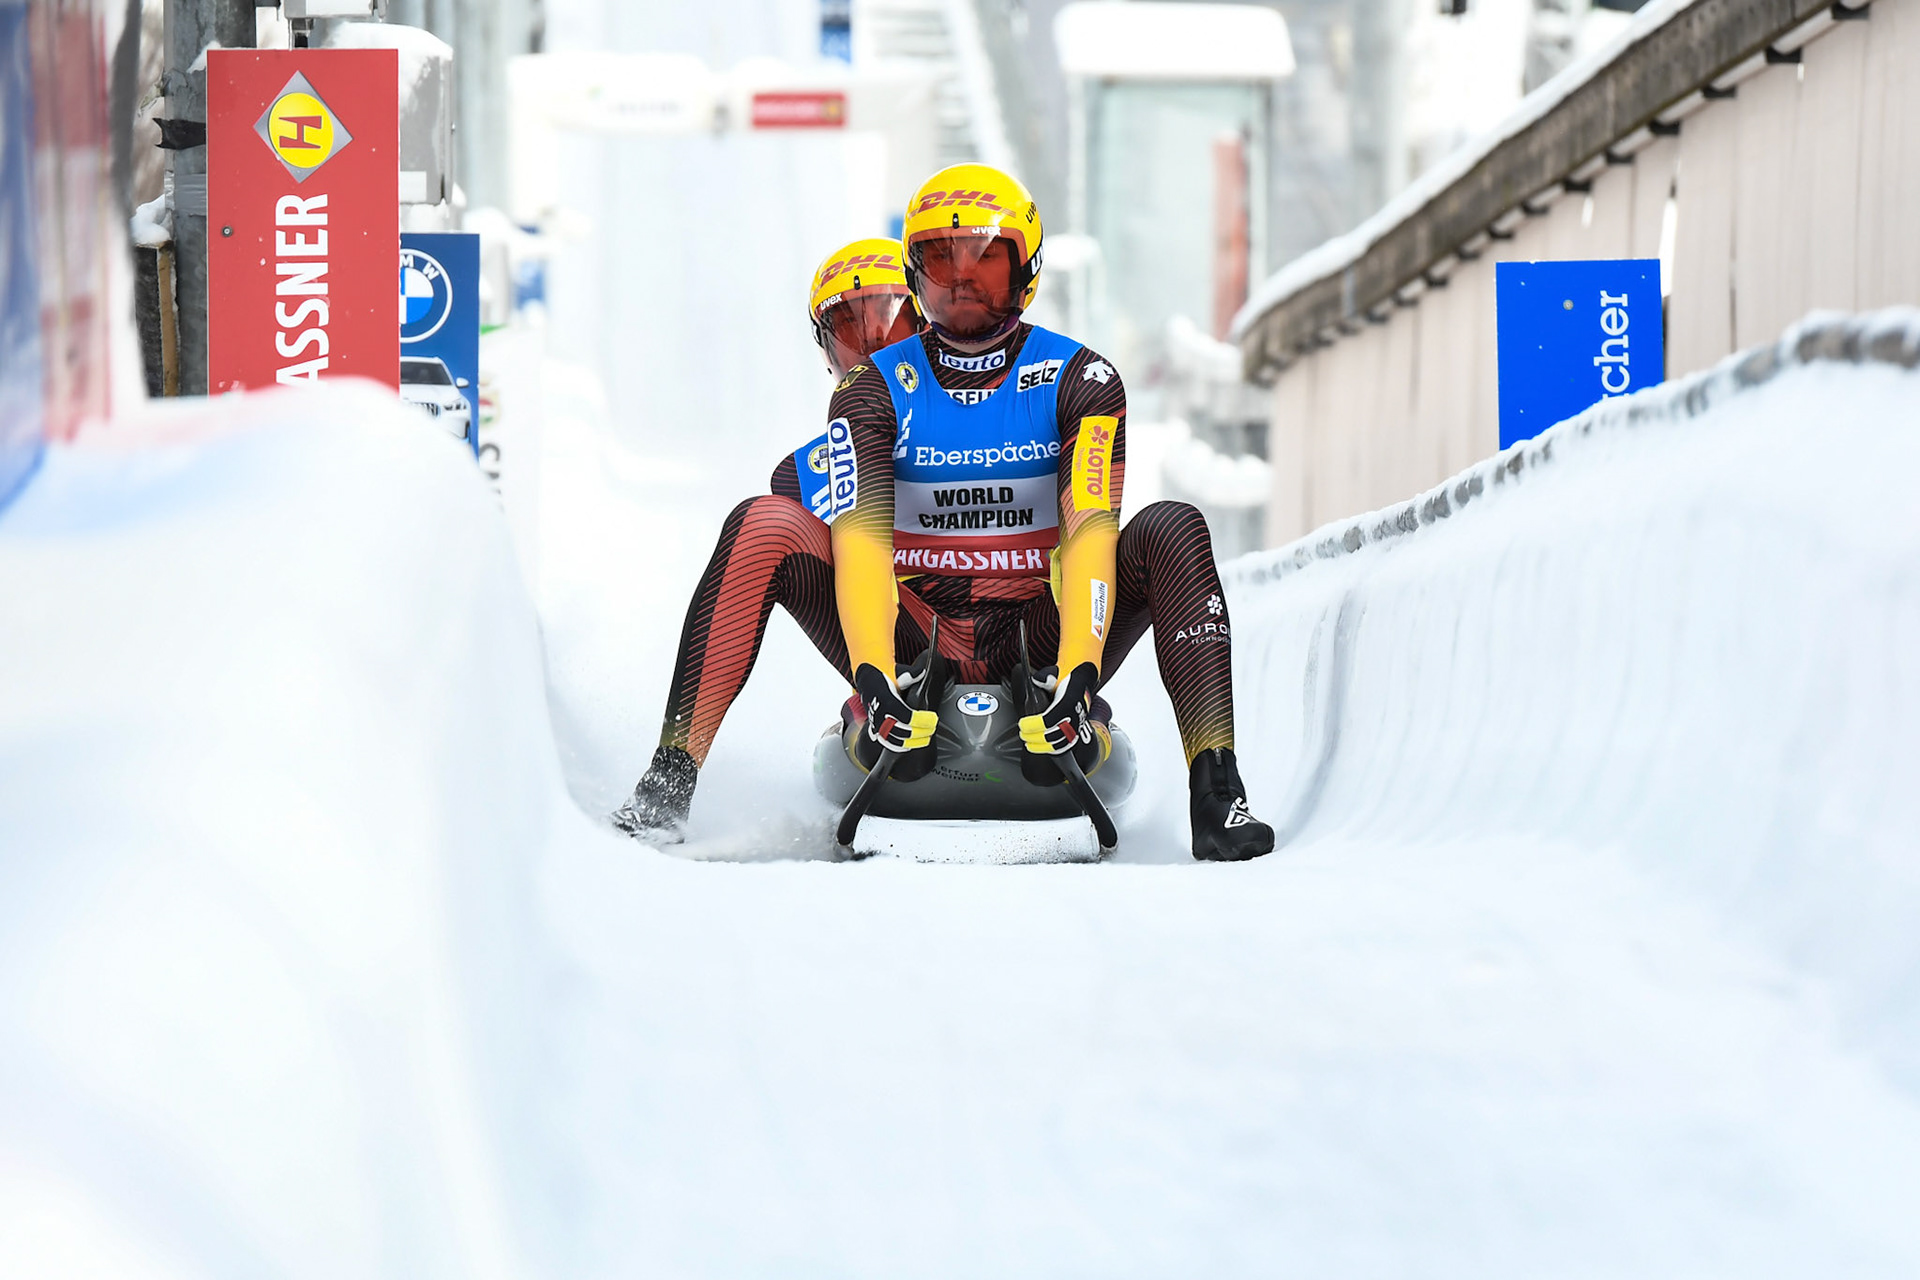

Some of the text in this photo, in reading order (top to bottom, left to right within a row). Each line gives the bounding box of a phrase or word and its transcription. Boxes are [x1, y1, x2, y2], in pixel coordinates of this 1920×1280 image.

[918, 189, 1003, 213] DHL
[820, 254, 901, 289] DHL
[820, 292, 843, 311] uvex
[1593, 289, 1631, 399] cher
[941, 353, 1005, 371] teuto
[913, 440, 1062, 468] Eberspäche
[829, 421, 857, 516] teuto
[1086, 447, 1105, 496] LOTTO
[933, 486, 1014, 508] WORLD
[918, 508, 1033, 530] CHAMPION
[892, 548, 1044, 570] ARGASSNER
[1175, 622, 1231, 642] AURO
